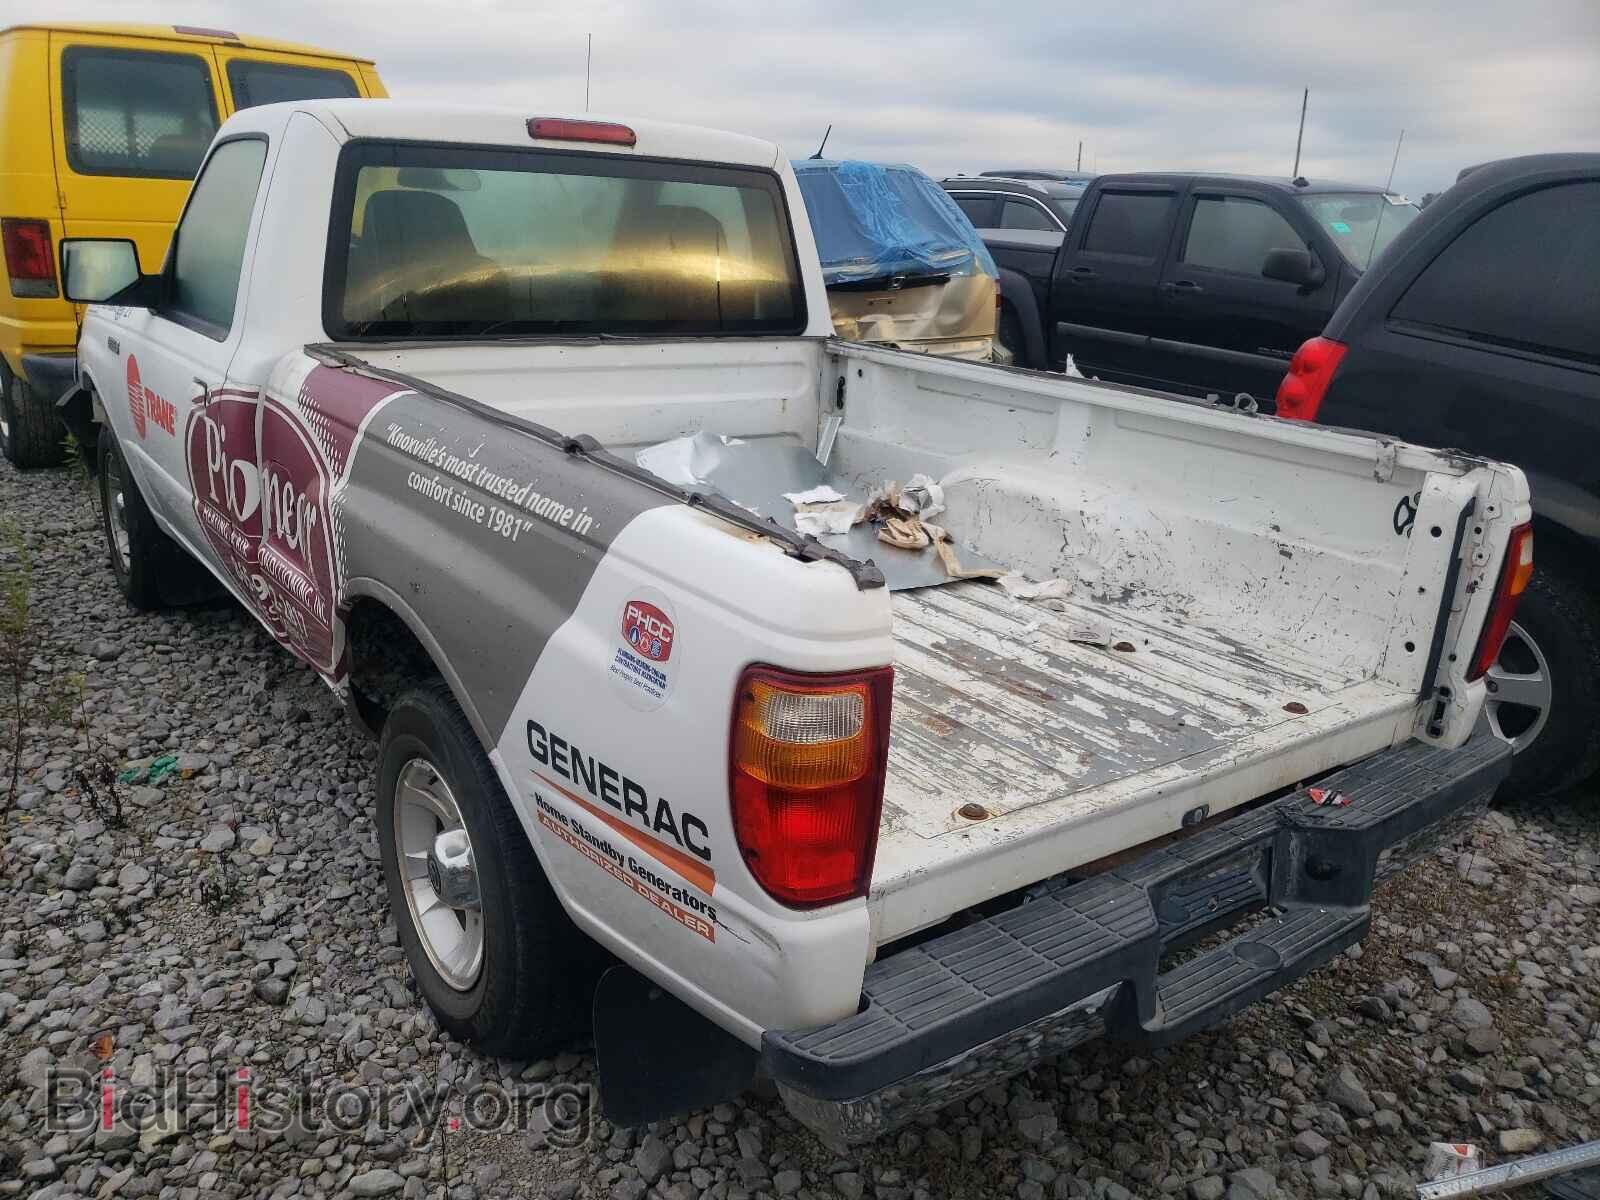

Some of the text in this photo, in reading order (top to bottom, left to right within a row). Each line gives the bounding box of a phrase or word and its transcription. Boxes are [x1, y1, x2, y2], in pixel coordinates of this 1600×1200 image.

[143, 386, 177, 438] TRANE
[387, 422, 593, 535] "Knoxville's most trusted name in
[408, 472, 533, 541] comfort since 1981"
[627, 605, 674, 643] PHCC
[527, 719, 712, 862] GENERAC
[535, 791, 717, 922] Home Standby Generators
[541, 815, 710, 937] AUTHORIZED DEALER
